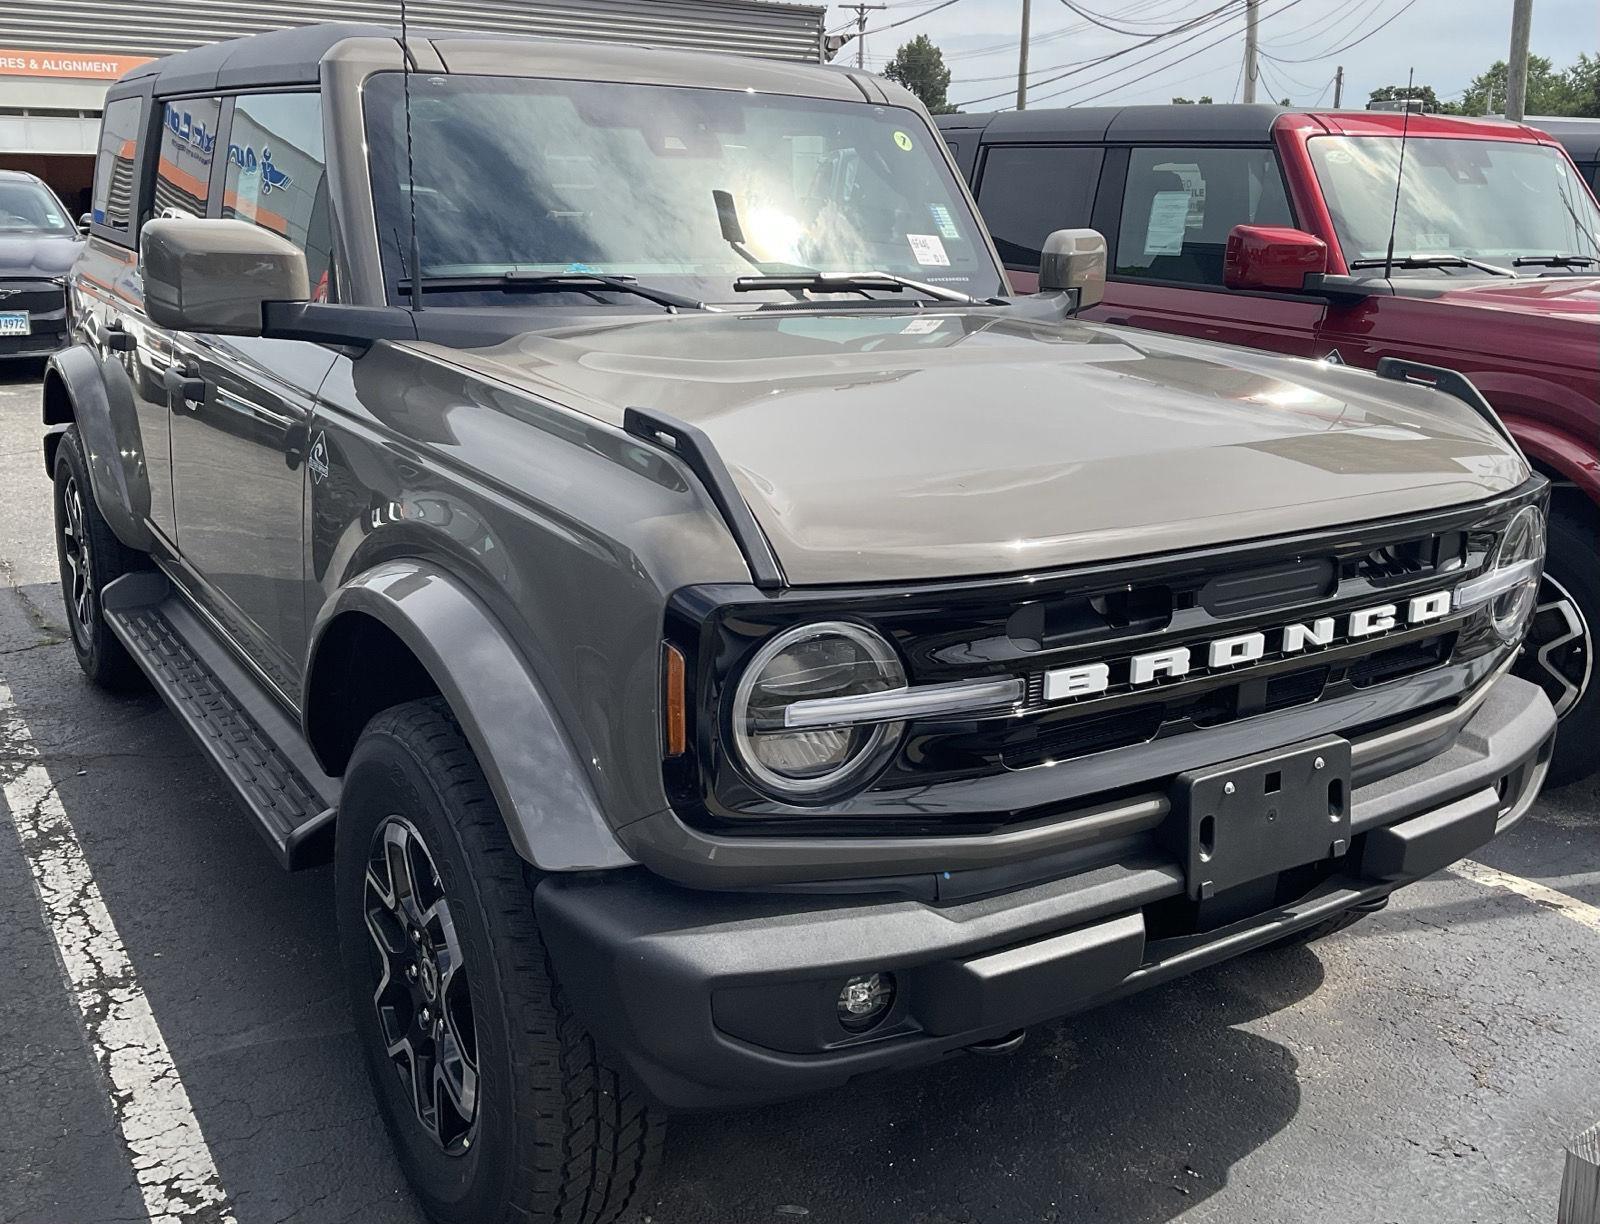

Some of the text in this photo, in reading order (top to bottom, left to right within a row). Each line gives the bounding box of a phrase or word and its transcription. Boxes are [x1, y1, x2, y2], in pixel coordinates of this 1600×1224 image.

[0, 57, 119, 73] RES & ALIGNMENT
[1043, 590, 1451, 701] BRONCO
